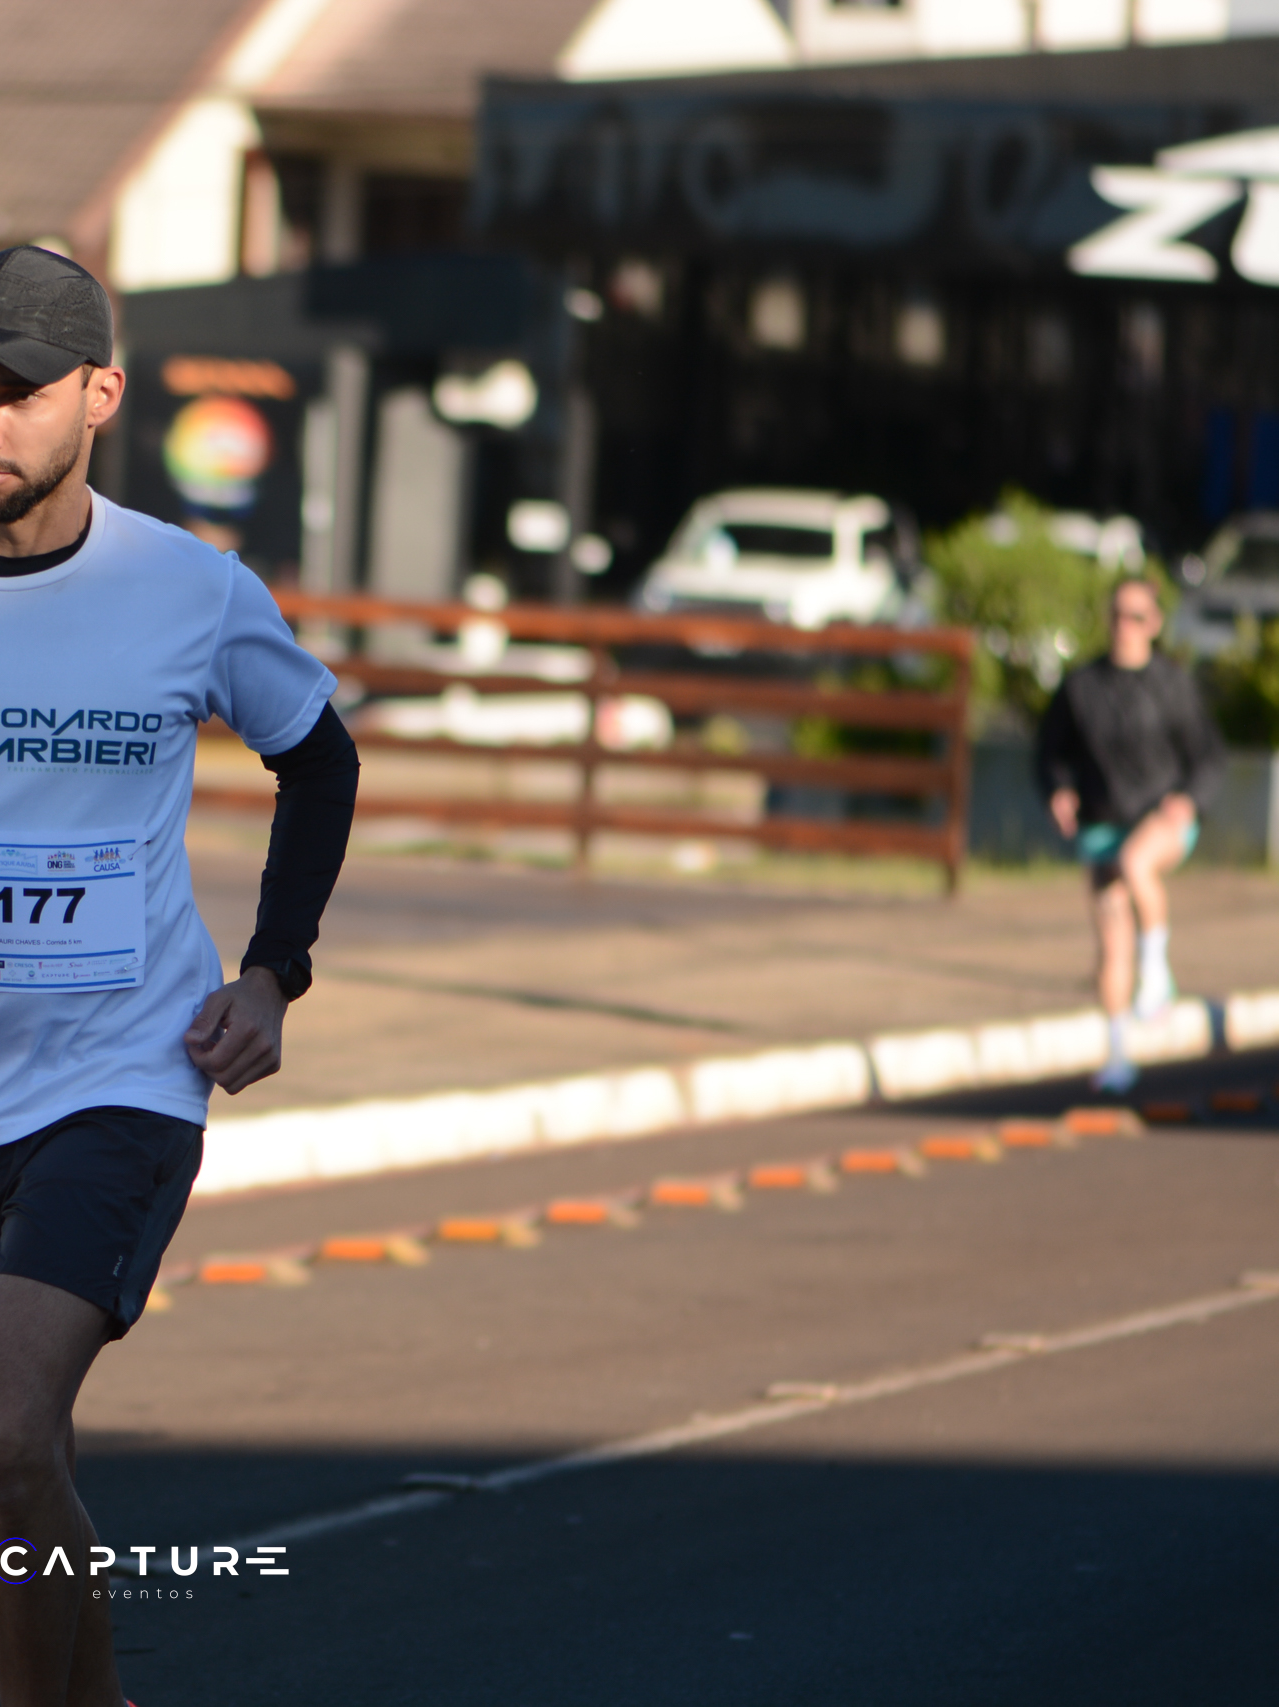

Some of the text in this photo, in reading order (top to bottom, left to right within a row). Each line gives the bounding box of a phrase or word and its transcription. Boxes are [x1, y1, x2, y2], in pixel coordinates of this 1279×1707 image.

[7, 766, 78, 774] TREINAMENTO
[47, 860, 63, 869] ONG
[93, 862, 121, 872] CAUSA
